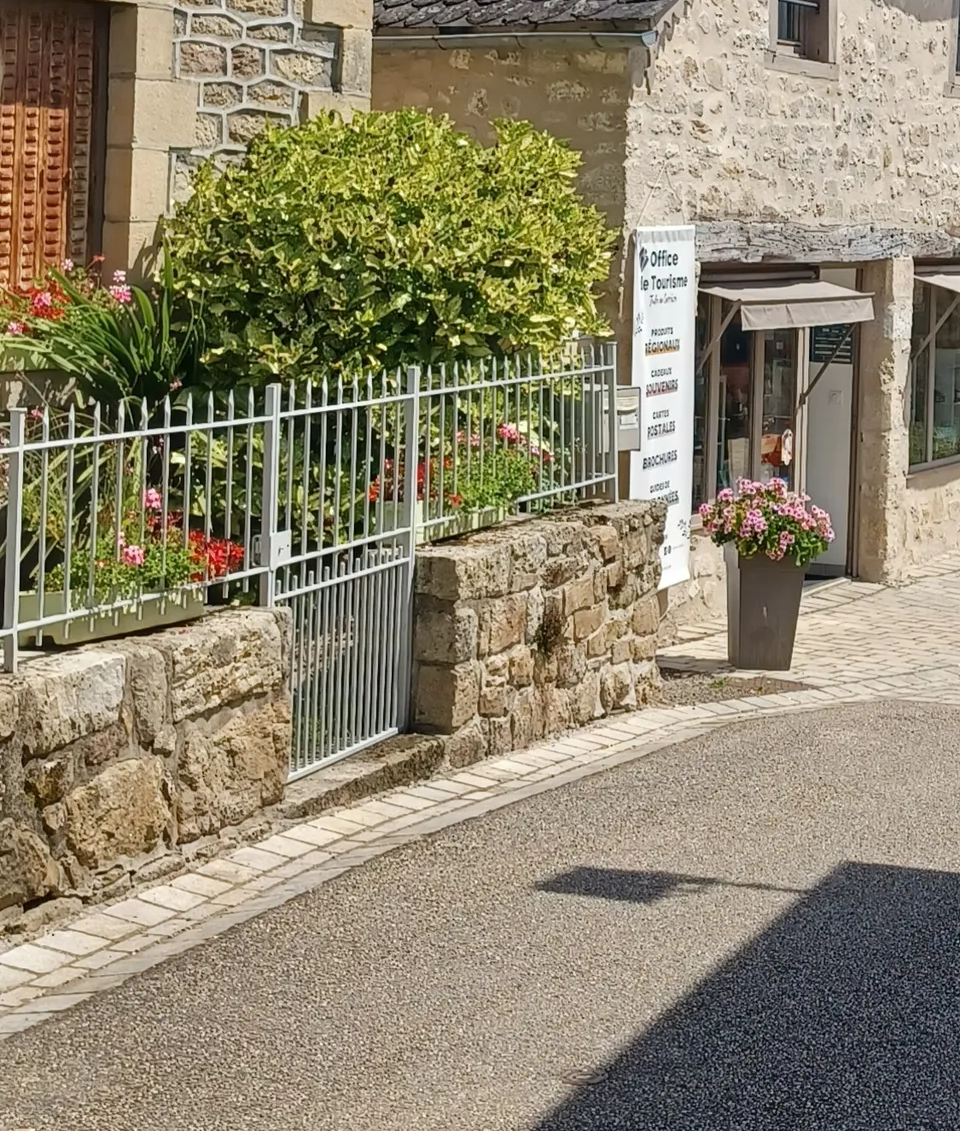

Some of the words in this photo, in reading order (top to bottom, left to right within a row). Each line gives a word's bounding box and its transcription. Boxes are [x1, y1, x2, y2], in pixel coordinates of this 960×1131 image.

[650, 250, 679, 267] Office
[651, 274, 688, 291] Tourisme
[651, 327, 674, 337] PRODUITS
[645, 339, 680, 356] RÉGIONAUX
[651, 367, 672, 377] CADEAUX
[646, 379, 678, 397] SOUVENIRS
[652, 409, 670, 419] CARTES
[647, 420, 676, 438] POSTALES
[642, 450, 678, 470] BROCHURES
